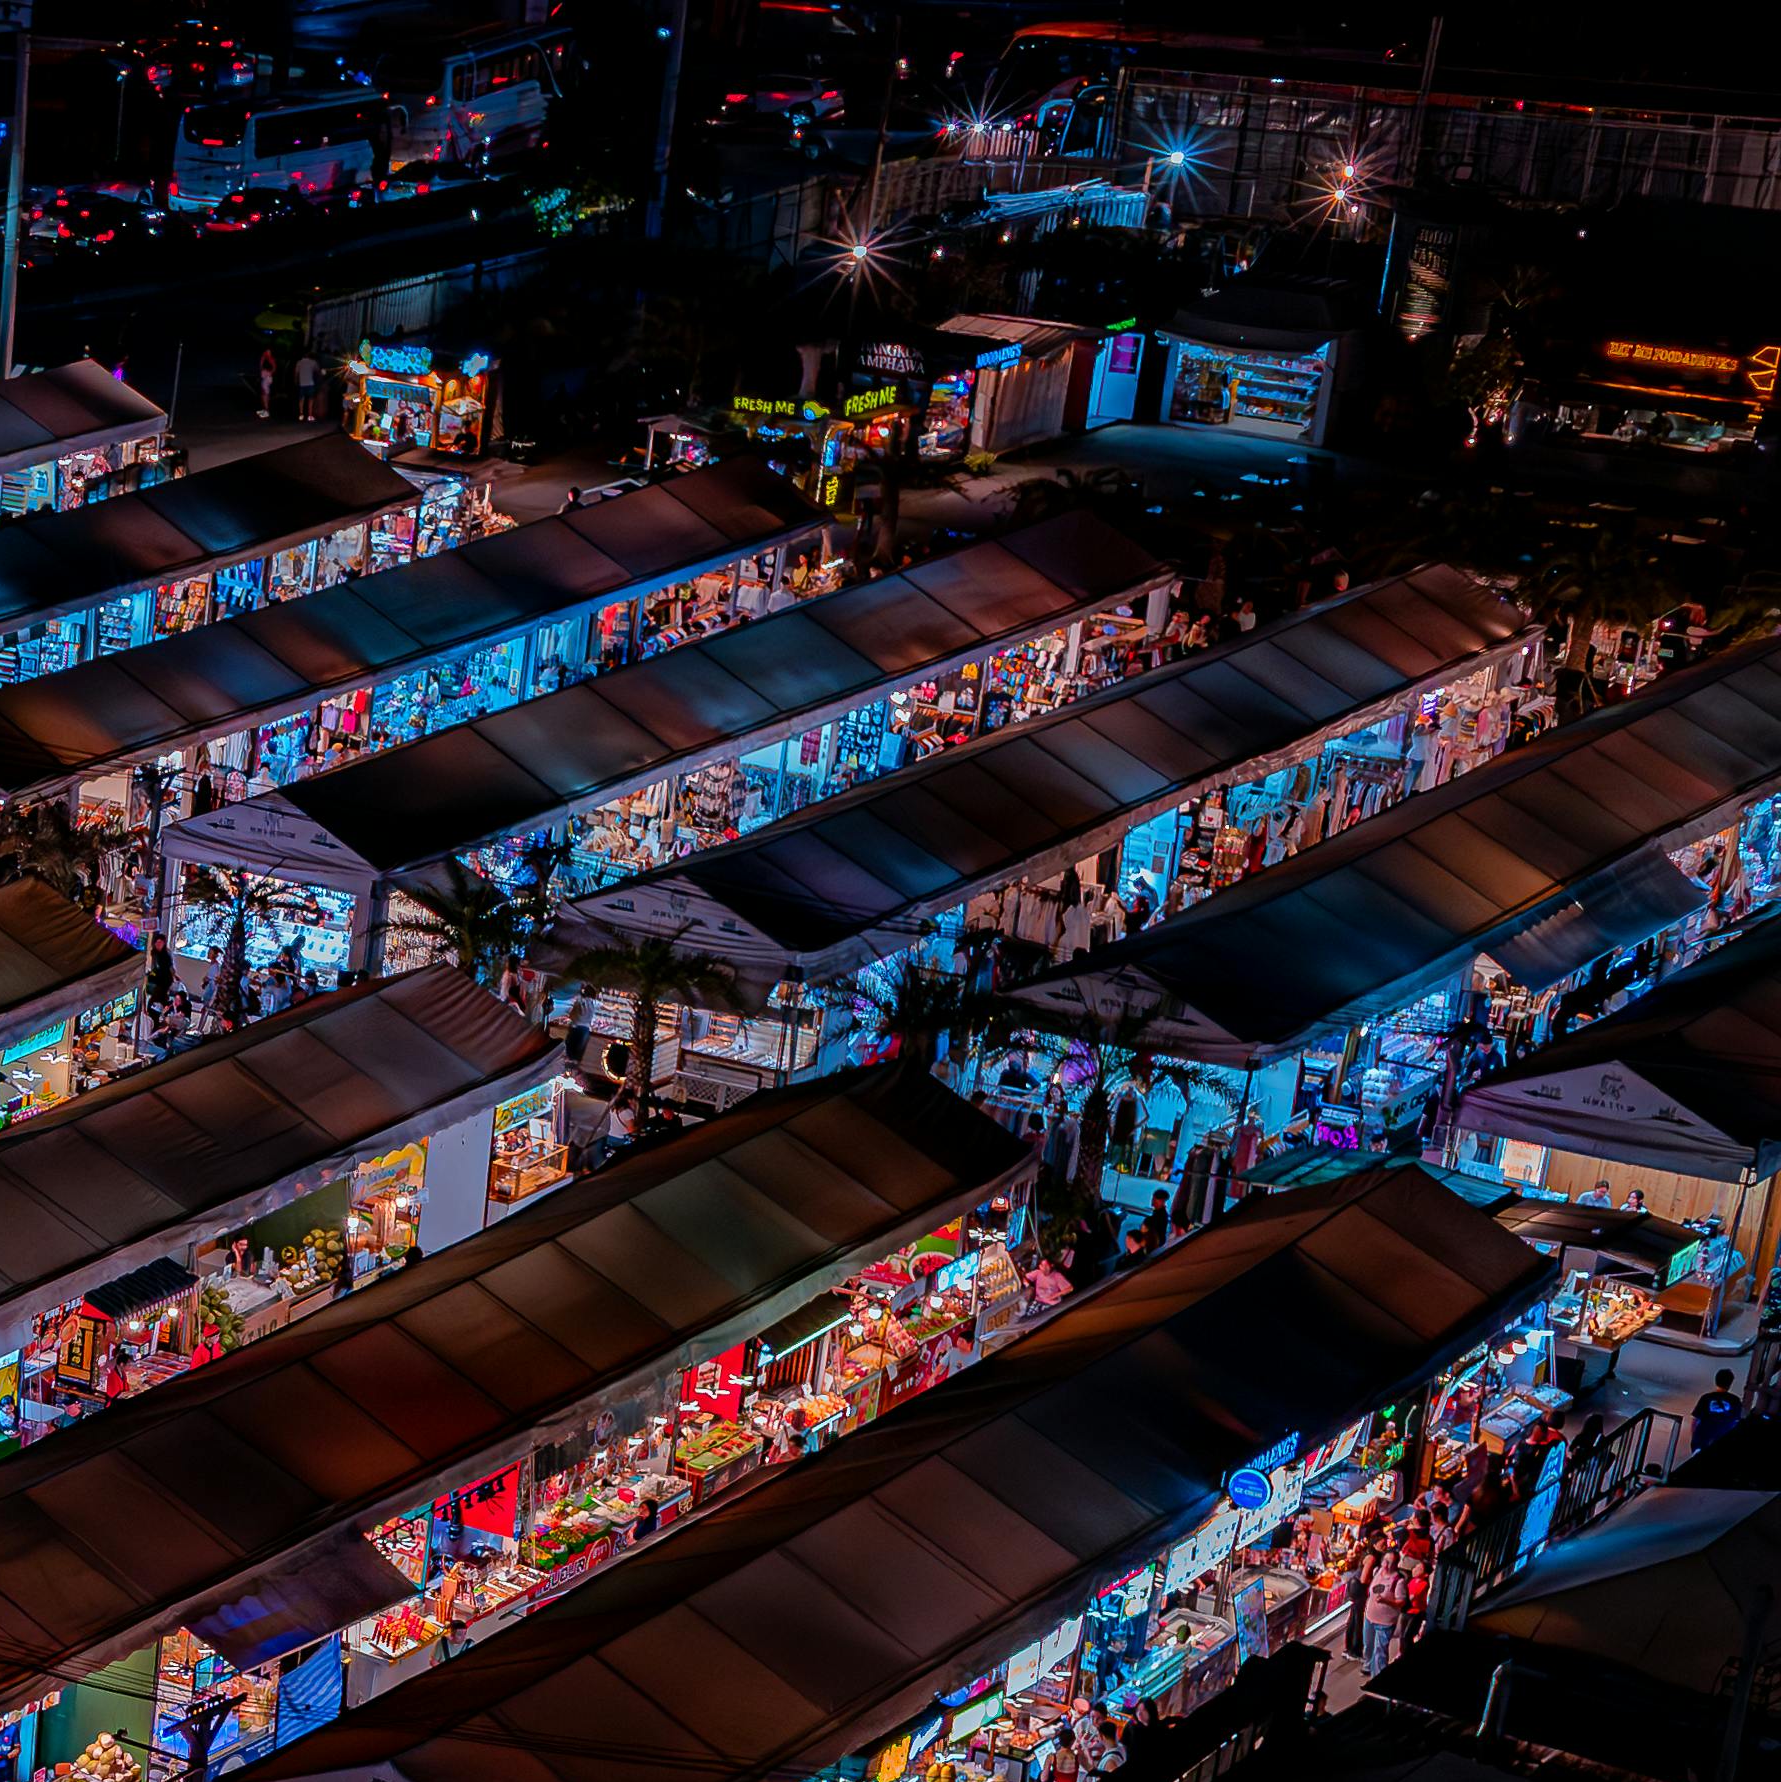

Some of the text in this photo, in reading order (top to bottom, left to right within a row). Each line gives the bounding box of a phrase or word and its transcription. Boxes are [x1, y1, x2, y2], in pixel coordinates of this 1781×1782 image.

[860, 355, 925, 375] AMPHAWA
[733, 396, 795, 416] FRESH ME
[845, 385, 897, 417] FRESH ME
